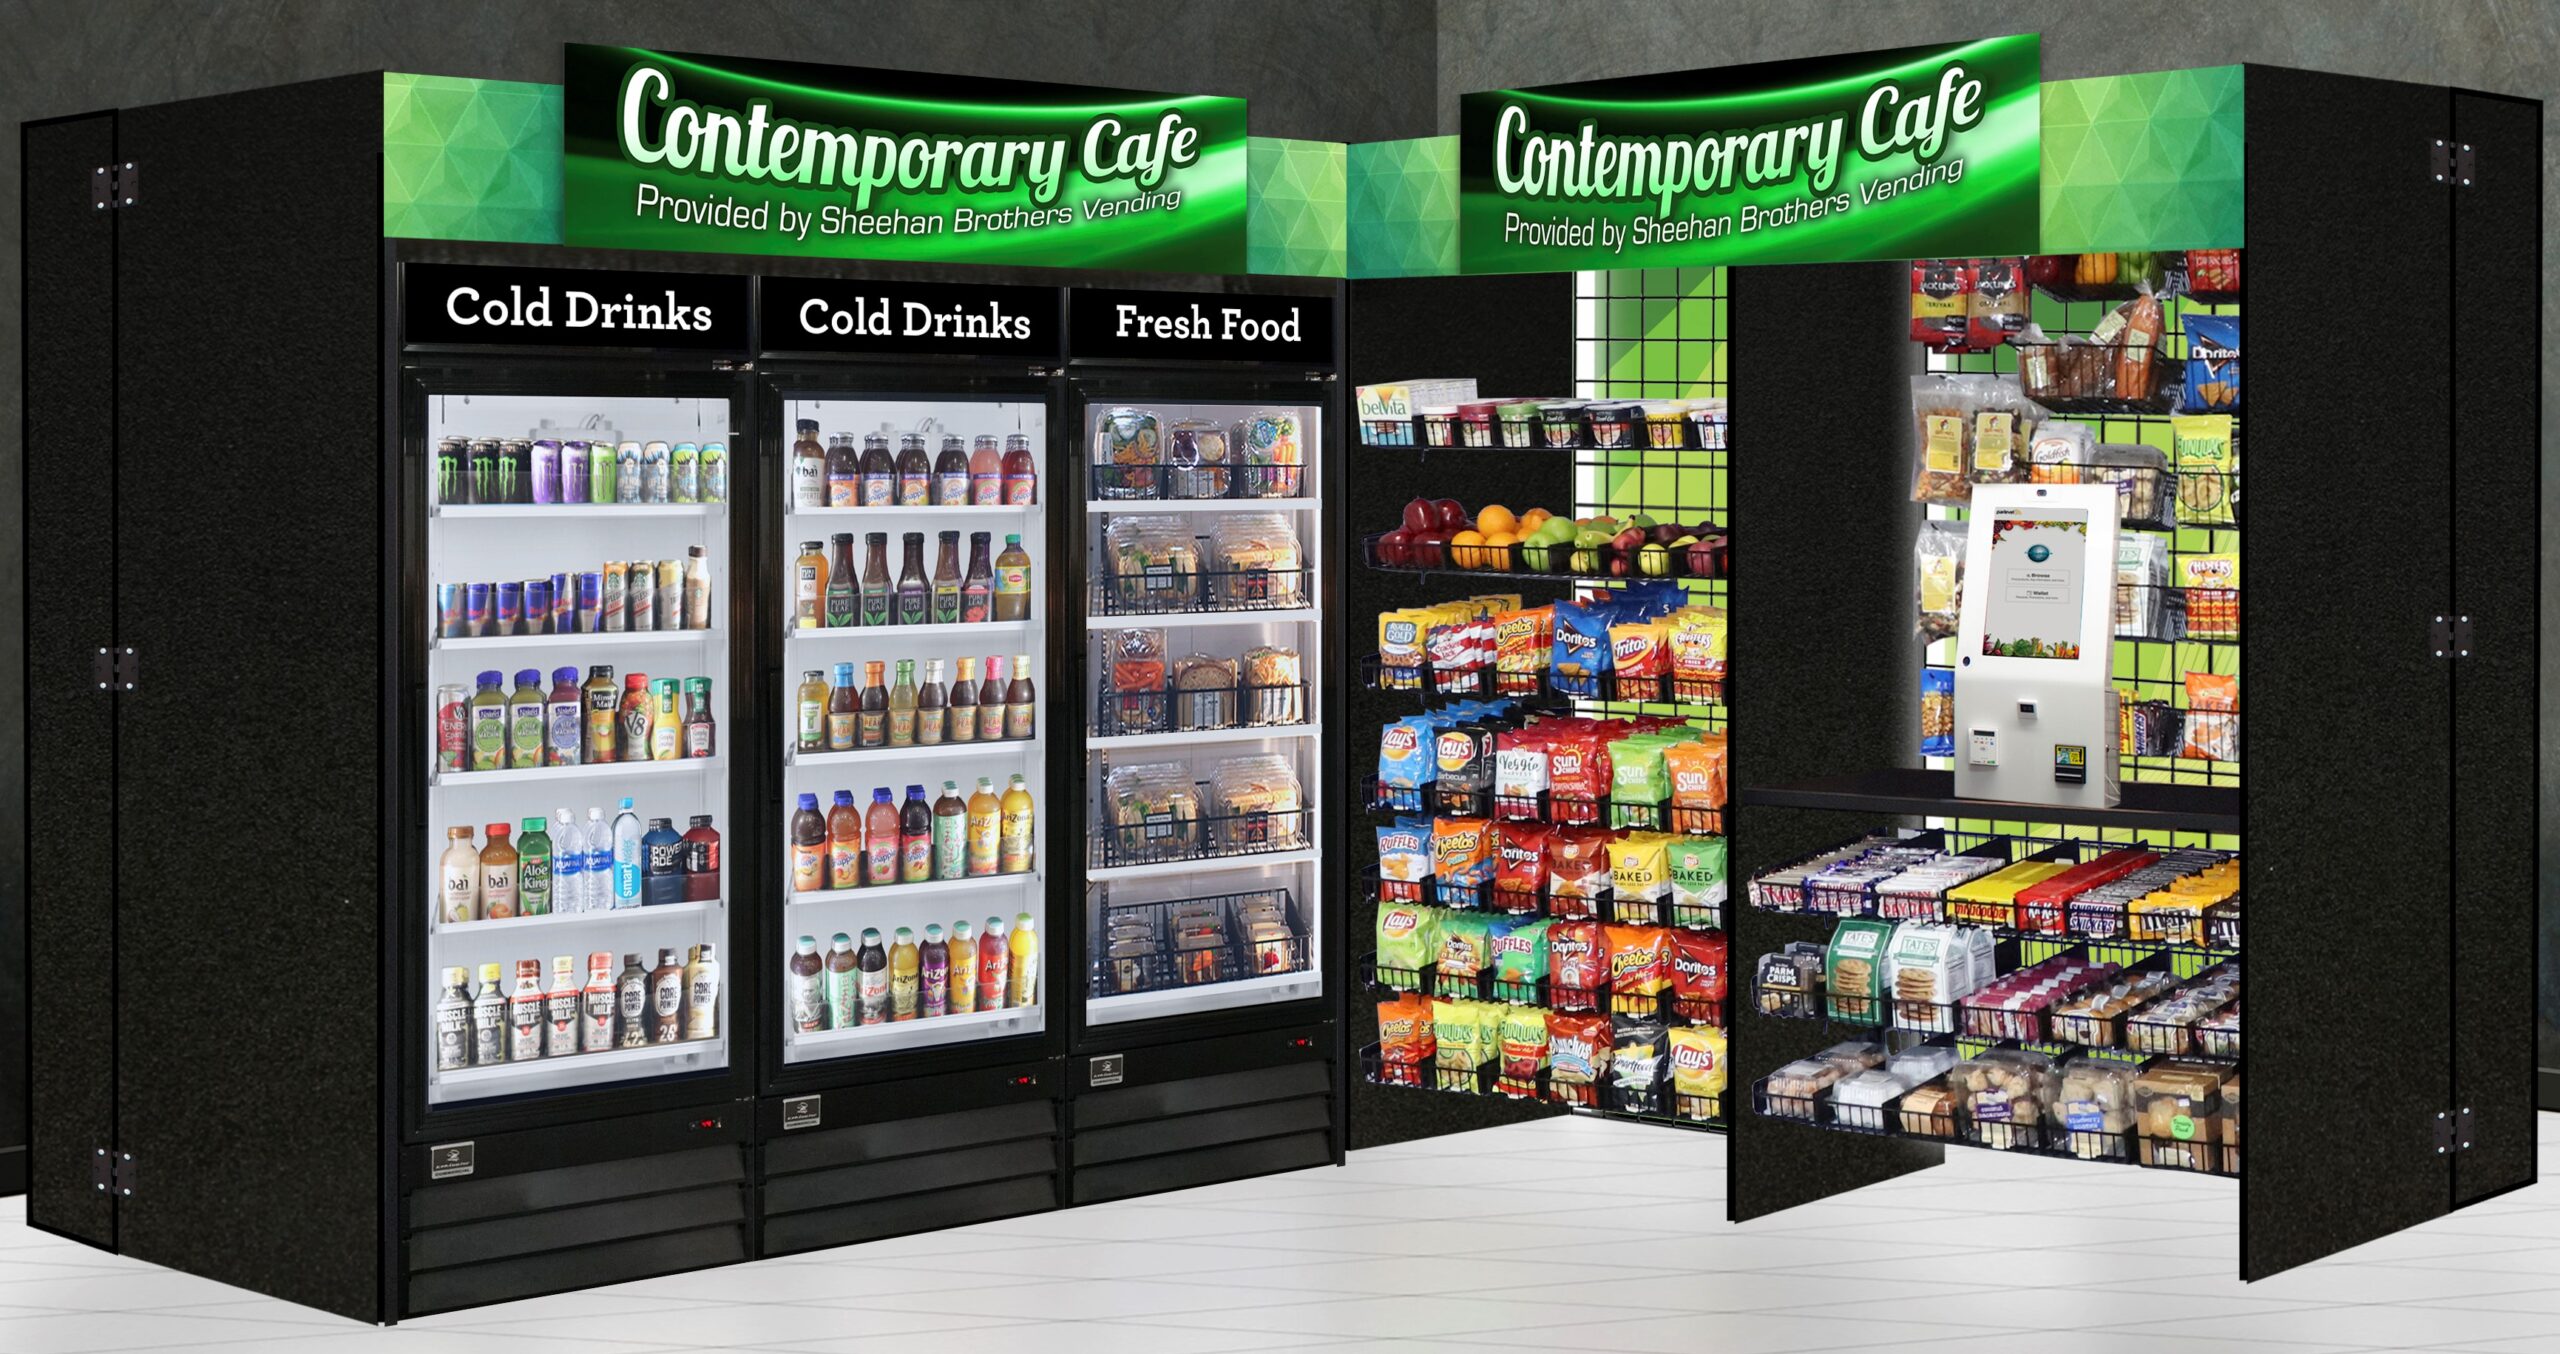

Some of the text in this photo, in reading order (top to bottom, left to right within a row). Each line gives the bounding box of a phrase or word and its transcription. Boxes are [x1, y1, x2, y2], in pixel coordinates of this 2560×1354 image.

[624, 67, 1197, 211] Contemporary Cafe
[1496, 67, 1981, 220] Contemporary Cafe
[636, 183, 1182, 241] Provided by Sheehan Brothers Vending
[1505, 158, 1964, 254] Provided by Sheehan Brothers Vending
[447, 286, 711, 331] Cold Drinks
[800, 297, 1030, 339] Cold Drinks
[1117, 304, 1301, 341] Fresh Food
[1497, 619, 1534, 643] Cheetos
[1556, 629, 1597, 648] Doritos
[1614, 638, 1648, 658] Fritos
[625, 711, 646, 736] V8
[1380, 835, 1418, 852] RUFFLES
[1436, 833, 1477, 861] Cheetos
[524, 864, 548, 876] Aloe
[1614, 870, 1652, 881] BAKED
[1672, 869, 1713, 882] BAKED
[524, 877, 549, 889] King
[1492, 937, 1532, 955] RUFFLES
[1552, 941, 1588, 953] Doritos
[1611, 950, 1654, 978] Cheetos
[1674, 958, 1717, 977] Doritos
[1769, 967, 1794, 976] PARM
[1767, 975, 1797, 986] CRISPS
[1675, 1045, 1713, 1070] Lay's
